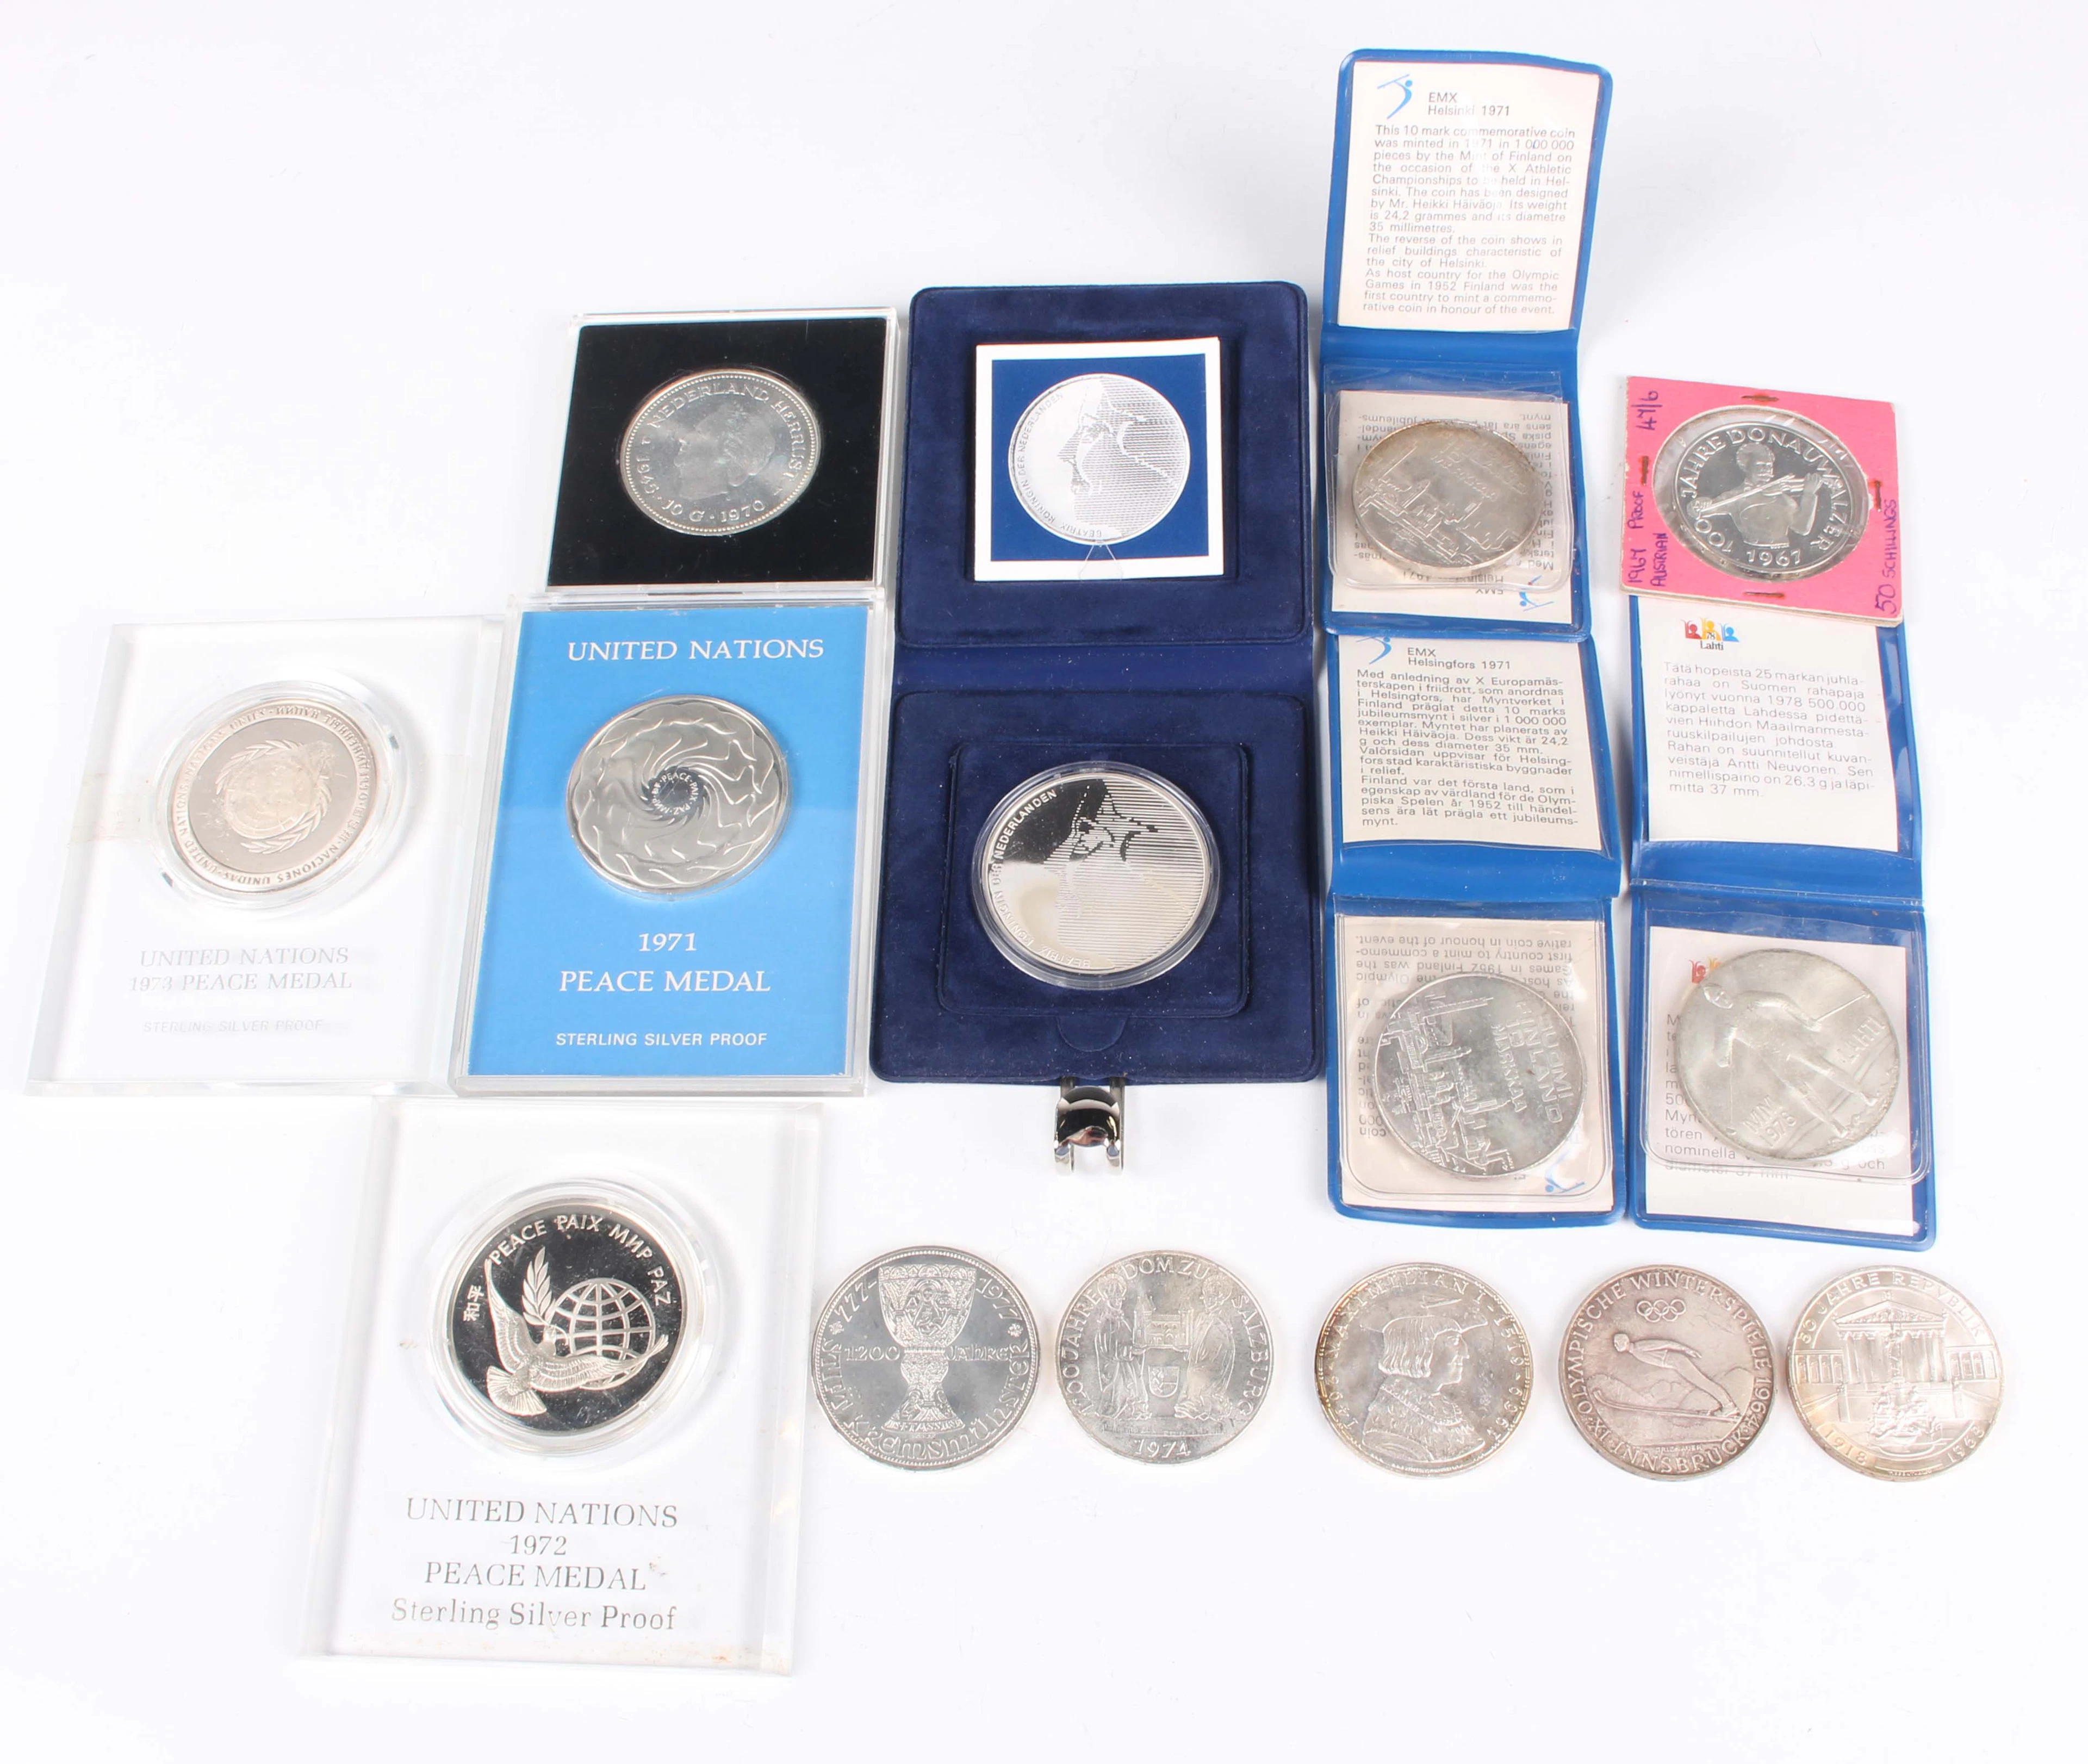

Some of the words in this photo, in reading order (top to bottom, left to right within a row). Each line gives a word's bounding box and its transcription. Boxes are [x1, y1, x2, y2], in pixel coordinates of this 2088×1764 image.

[1428, 91, 1458, 103] EMX
[1482, 104, 1509, 117] 1971
[1368, 233, 1390, 243] The
[1395, 235, 1435, 244] reverse
[1441, 234, 1453, 245] of
[1458, 234, 1476, 245] the
[1481, 235, 1505, 245] coin
[1510, 234, 1547, 246] shows
[1552, 235, 1563, 246] in
[1367, 245, 1397, 255] relief
[1405, 246, 1457, 256] buildings
[1466, 247, 1542, 257] characteristic
[1550, 247, 1562, 258] of
[1366, 256, 1385, 266] the
[1392, 256, 1414, 269] city
[1420, 257, 1432, 268] of
[1439, 258, 1487, 269] Helsinki.
[647, 384, 769, 428] NEDERLAND
[1019, 392, 1064, 452] NEDERLANDEN
[1017, 455, 1026, 475] DER
[721, 500, 765, 523] 1970
[1022, 480, 1056, 524] KONINGIN
[1060, 521, 1103, 538] BEATRIX
[1650, 532, 1668, 587] AUSTRIAN
[1746, 548, 1801, 566] 1967
[1875, 583, 1898, 615] 50
[568, 640, 678, 661] UNITED
[689, 638, 825, 660] NATIONS
[1407, 647, 1436, 657] EMX
[1700, 640, 1724, 651] Lahti
[1408, 656, 1476, 670] Helsingfors
[1481, 660, 1510, 670] 1971
[1664, 676, 1701, 687] rahaa
[1741, 680, 1797, 693] Suomen
[1807, 686, 1865, 700] rahapaja
[1358, 698, 1402, 709] Finland
[1412, 703, 1455, 712] präglat
[1463, 704, 1495, 713] detta
[1505, 706, 1520, 715] 10
[1529, 707, 1566, 716] marks
[1711, 694, 1761, 704] vuonna
[1767, 694, 1803, 707] 1978
[1666, 701, 1736, 715] kappaletta
[1744, 706, 1807, 720] Lahdessa
[1668, 740, 1711, 753] Rahan
[1717, 746, 1735, 755] on
[1742, 748, 1820, 761] suunnitellut
[1827, 750, 1872, 763] kuvan-
[661, 772, 692, 783] PEACE
[1669, 783, 1704, 793] mitta
[1710, 783, 1727, 795] 37
[1733, 787, 1764, 797] mm.
[1362, 796, 1394, 806] piska
[1401, 796, 1444, 809] Spelen
[1451, 798, 1462, 810] år
[1469, 799, 1501, 810] 1952
[1507, 803, 1523, 811] till
[1530, 804, 1577, 815] händel-
[1362, 817, 1399, 828] mynt.
[1396, 806, 1416, 816] ära
[1422, 807, 1438, 816] lät
[1444, 809, 1483, 819] prägla
[1490, 812, 1507, 821] ett
[1513, 812, 1579, 825] jubileums-
[994, 789, 1058, 864] NEDERLANDEN
[277, 843, 340, 884] NACIONES
[991, 862, 1003, 887] DER
[994, 891, 1035, 947] KONINGIN
[638, 932, 697, 952] 1971
[1356, 935, 1394, 944] event.
[1399, 936, 1419, 946] the
[1423, 936, 1435, 947] of
[1440, 937, 1485, 948] honour
[1490, 938, 1501, 946] in
[1506, 939, 1533, 947] coin
[1537, 940, 1571, 949] rative
[140, 948, 230, 967] UNITED
[240, 946, 350, 965] NATIONS
[1040, 945, 1090, 968] BEATRIX
[129, 976, 173, 992] 1973
[182, 973, 258, 991] PEACE
[267, 971, 353, 990] MEDAL
[559, 970, 654, 992] PEACE
[663, 970, 771, 992] MEDAL
[144, 1021, 213, 1033] STERLING
[219, 1020, 269, 1033] SILVER
[276, 1018, 324, 1032] PROOF
[556, 1033, 637, 1046] STERLING
[644, 1033, 703, 1046] SILVER
[710, 1033, 767, 1046] PROOF
[1665, 1127, 1702, 1140] tören
[1761, 1110, 1798, 1148] 1978
[1664, 1144, 1737, 1160] nominella
[488, 1219, 547, 1265] PEACE
[556, 1214, 604, 1232] PAIX
[647, 1265, 673, 1306] PAZ
[1817, 1272, 1881, 1316] JAHRE
[1061, 1289, 1105, 1361] JAHRE
[1122, 1257, 1174, 1281] DOM
[1179, 1259, 1210, 1280] ZU
[844, 1346, 900, 1361] 1200
[1567, 1283, 1627, 1415] OLYMPISCHE
[1630, 1271, 1772, 1370] WINTERSPIELE
[1747, 1376, 1773, 1430] 1964
[1133, 1439, 1192, 1458] 1974
[1613, 1432, 1747, 1474] INNSBRUCK
[1824, 1430, 1868, 1466] 1918
[406, 1497, 525, 1523] UNITED
[535, 1501, 679, 1529] NATIONS
[509, 1535, 568, 1556] 1972
[425, 1561, 525, 1587] PEACE
[535, 1564, 647, 1591] MEDAL
[391, 1598, 500, 1631] Sterling
[509, 1601, 592, 1628] Silver
[600, 1605, 678, 1631] Proof
